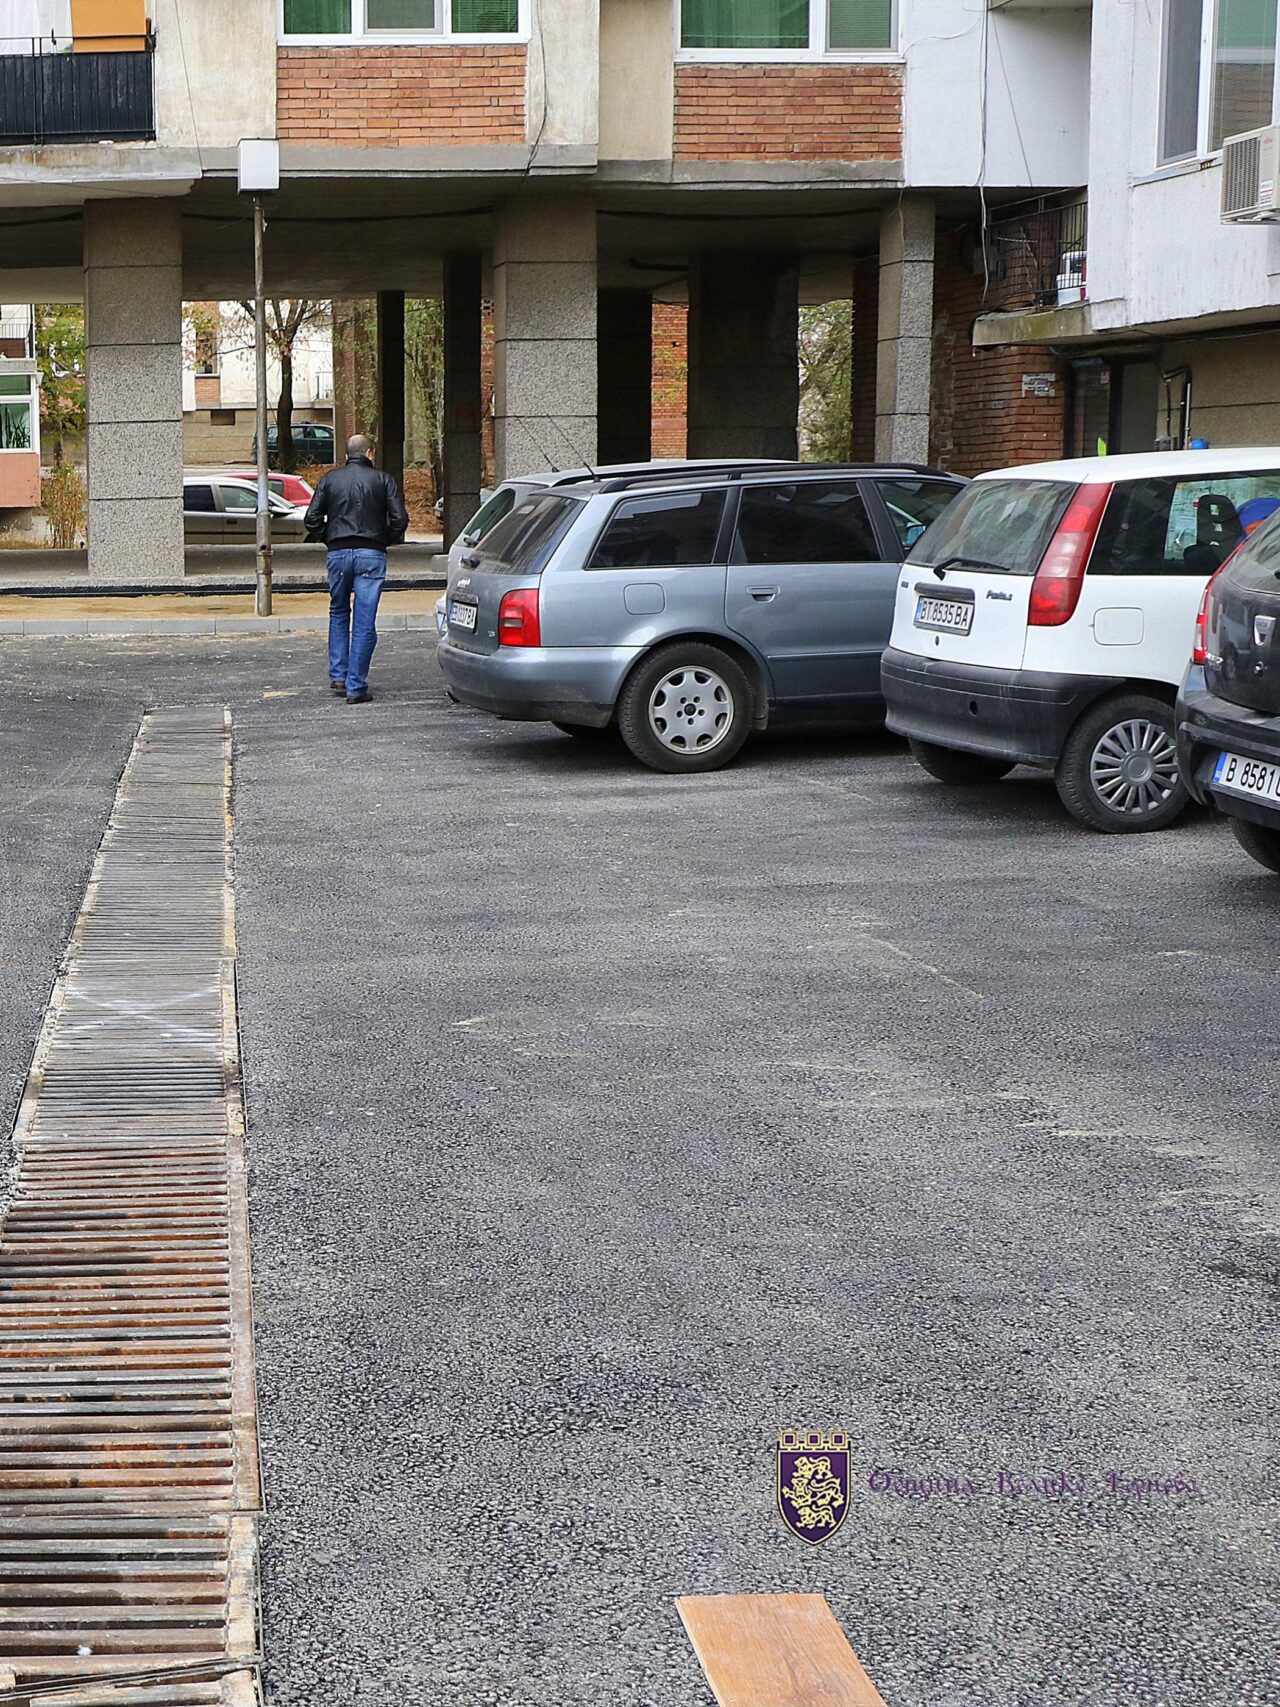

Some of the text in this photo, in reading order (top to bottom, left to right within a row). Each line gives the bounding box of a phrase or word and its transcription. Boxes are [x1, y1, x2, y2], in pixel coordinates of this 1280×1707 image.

[932, 602, 955, 624] 8535
[954, 606, 969, 627] BA
[1226, 757, 1238, 782] B
[1240, 762, 1276, 794] 8581
